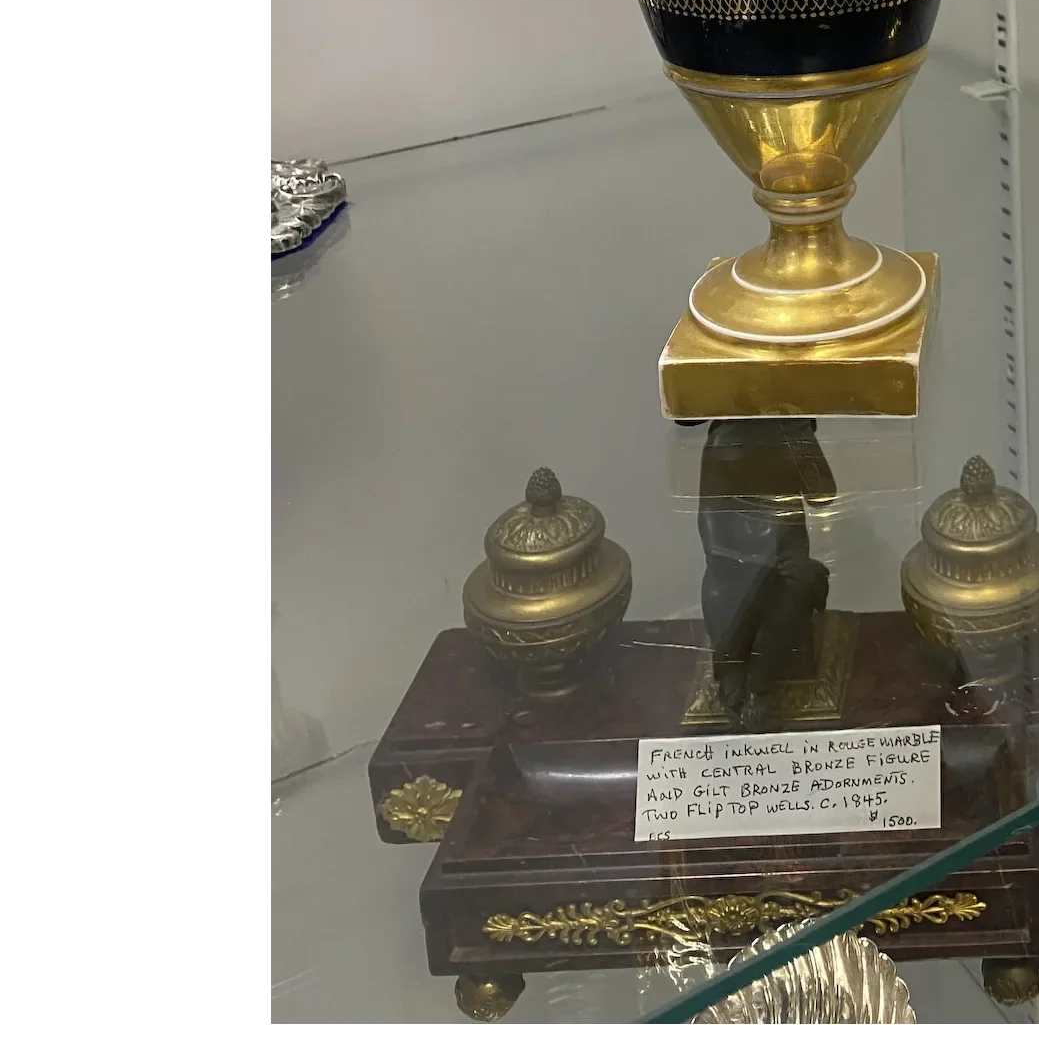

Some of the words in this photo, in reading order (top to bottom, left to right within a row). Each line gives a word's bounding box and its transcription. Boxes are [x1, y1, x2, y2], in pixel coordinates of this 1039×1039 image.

[650, 744, 714, 765] FRENCH
[803, 740, 819, 754] IN
[828, 737, 876, 753] ROUGE
[880, 731, 940, 747] MARBLE
[646, 766, 687, 781] WITH
[701, 763, 776, 778] CENTRAL
[792, 757, 855, 775] BRONZE
[866, 750, 930, 767] FIGURE
[647, 787, 683, 802] AND
[693, 784, 731, 798] GILT
[741, 780, 800, 798] BRONZE
[810, 770, 915, 792] ADORNMENTS.
[642, 808, 678, 822] TWO
[766, 799, 815, 813] WELLS.
[843, 791, 888, 808] 1845.
